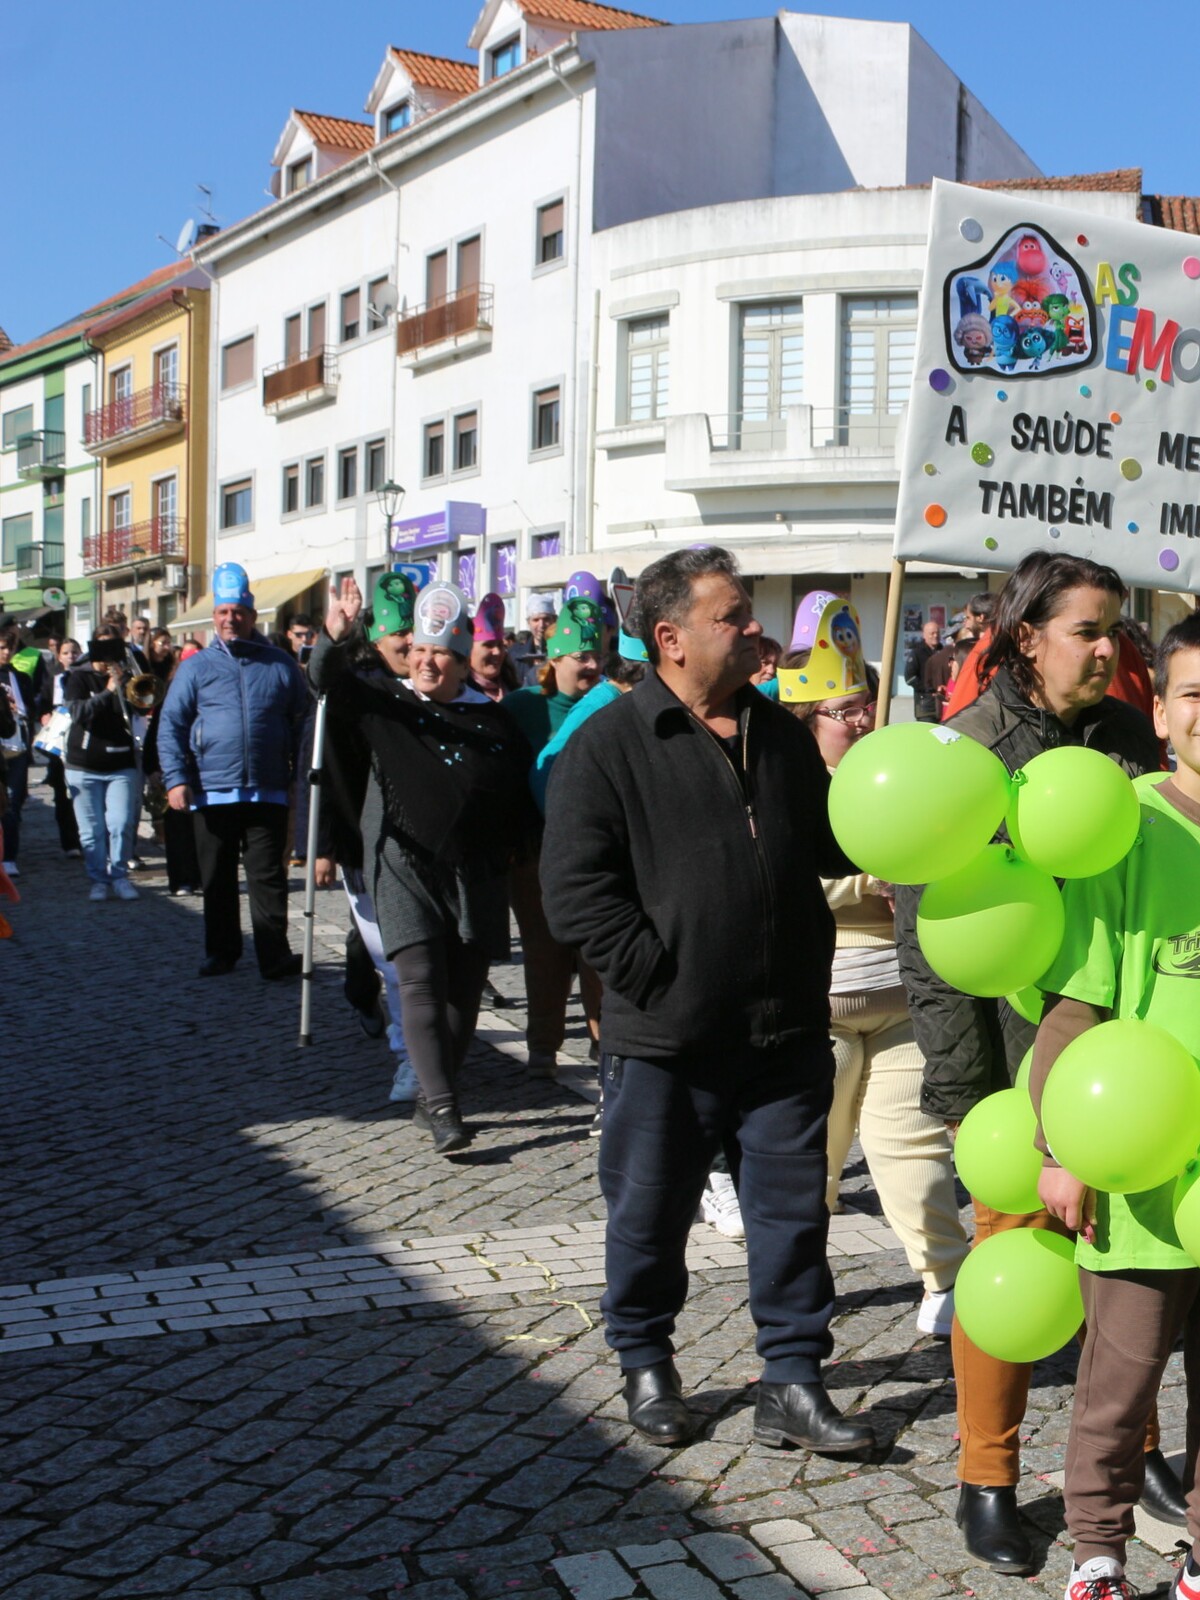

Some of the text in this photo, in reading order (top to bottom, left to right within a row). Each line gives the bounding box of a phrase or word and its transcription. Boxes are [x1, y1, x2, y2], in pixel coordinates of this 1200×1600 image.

[1095, 262, 1139, 305] AS
[945, 405, 966, 443] A
[1010, 411, 1112, 457] SAÚDE
[978, 476, 1112, 529] TAMBÉM
